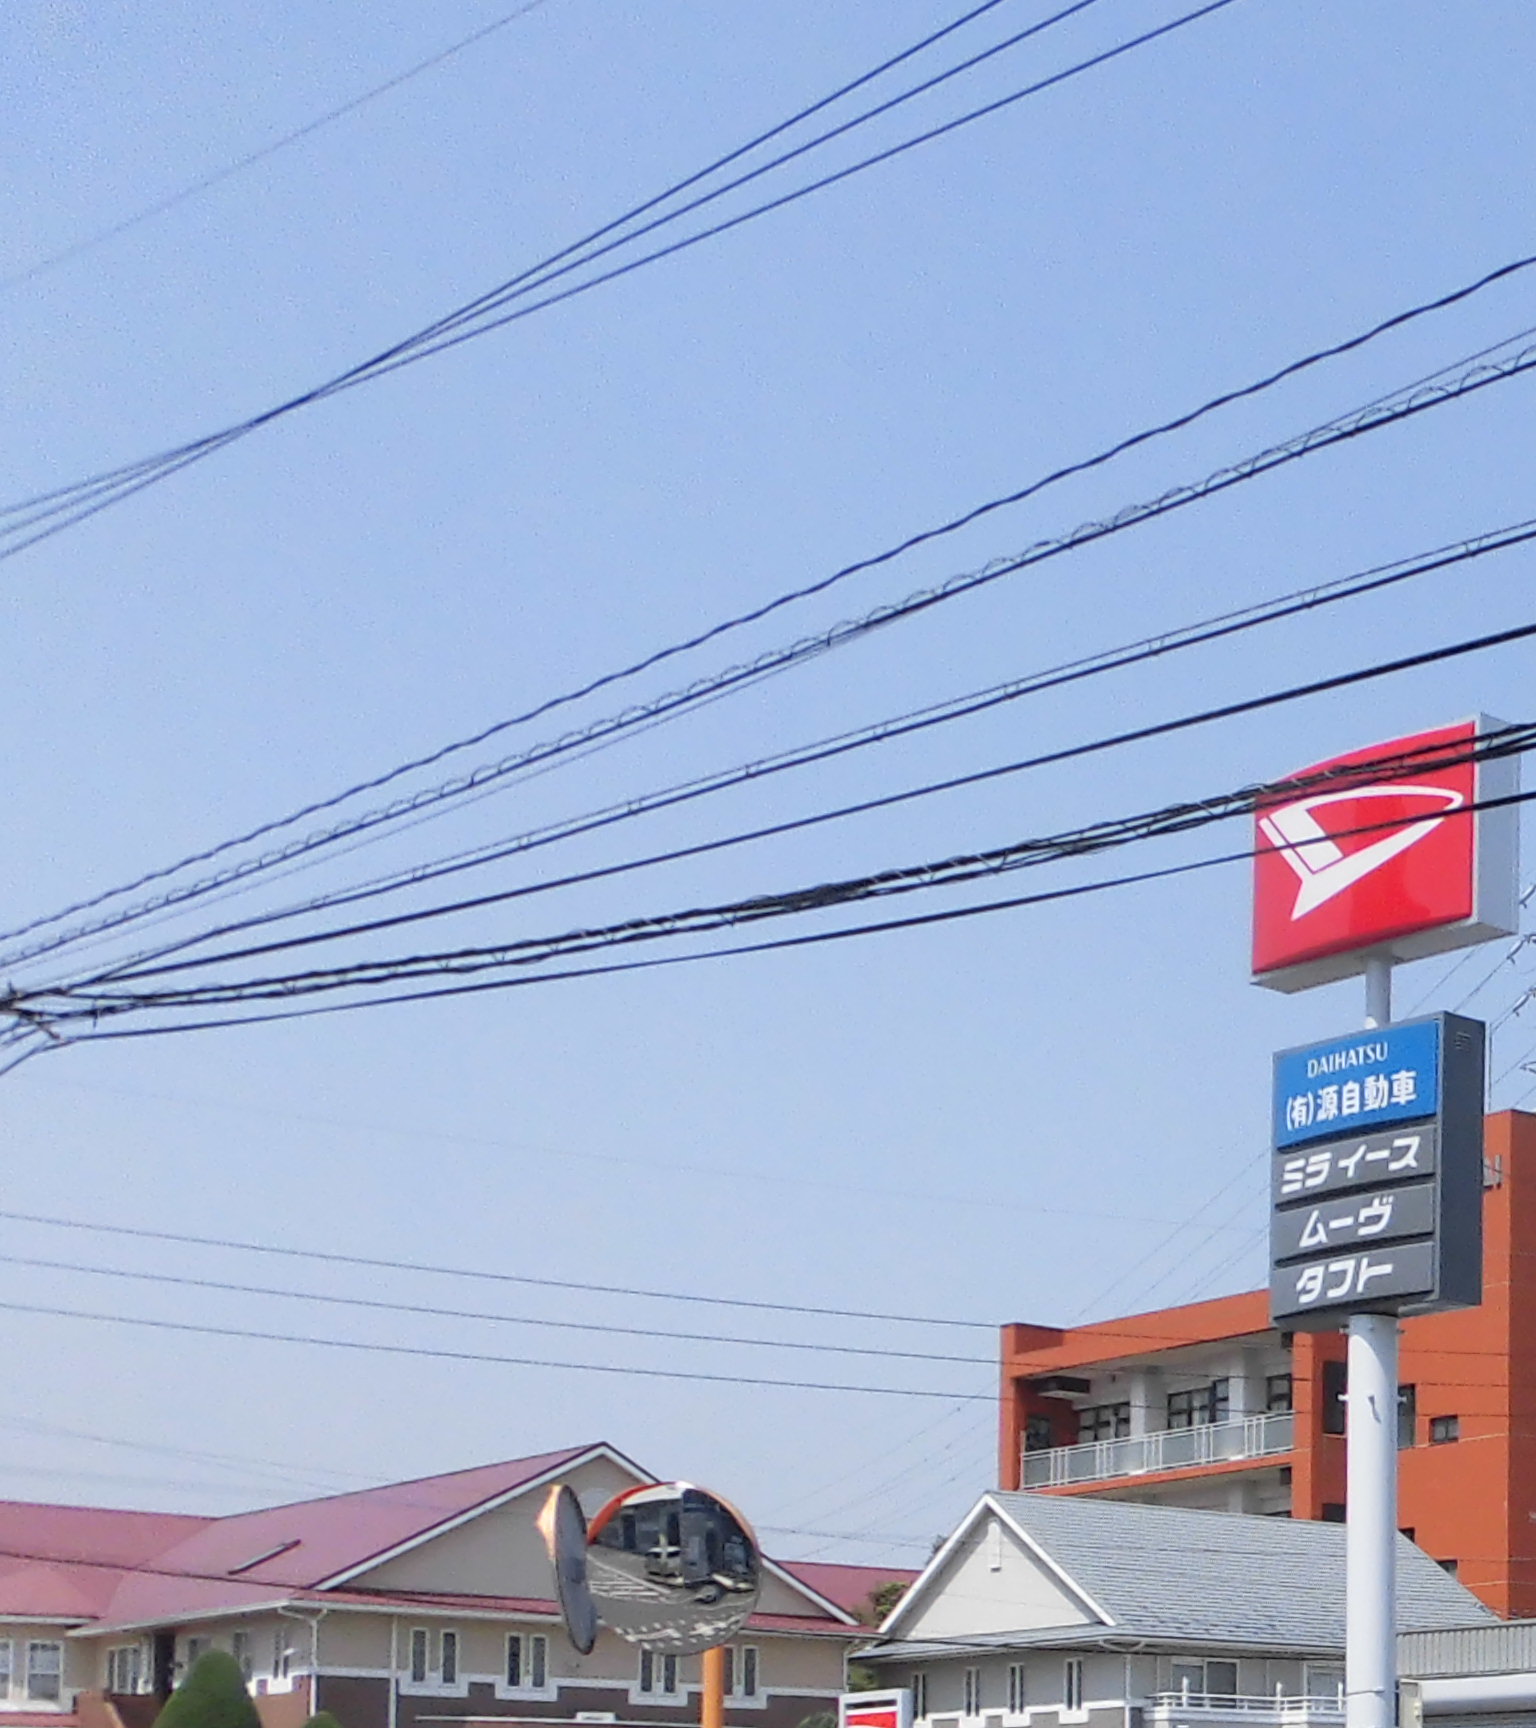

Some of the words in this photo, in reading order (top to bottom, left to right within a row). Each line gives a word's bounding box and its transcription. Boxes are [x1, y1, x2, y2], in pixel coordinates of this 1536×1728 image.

[1307, 1042, 1388, 1078] DAIHATSU
[1286, 1070, 1417, 1131] (有)源自動車
[1299, 1195, 1394, 1246] ムーヴ
[1296, 1258, 1393, 1304] タフト
